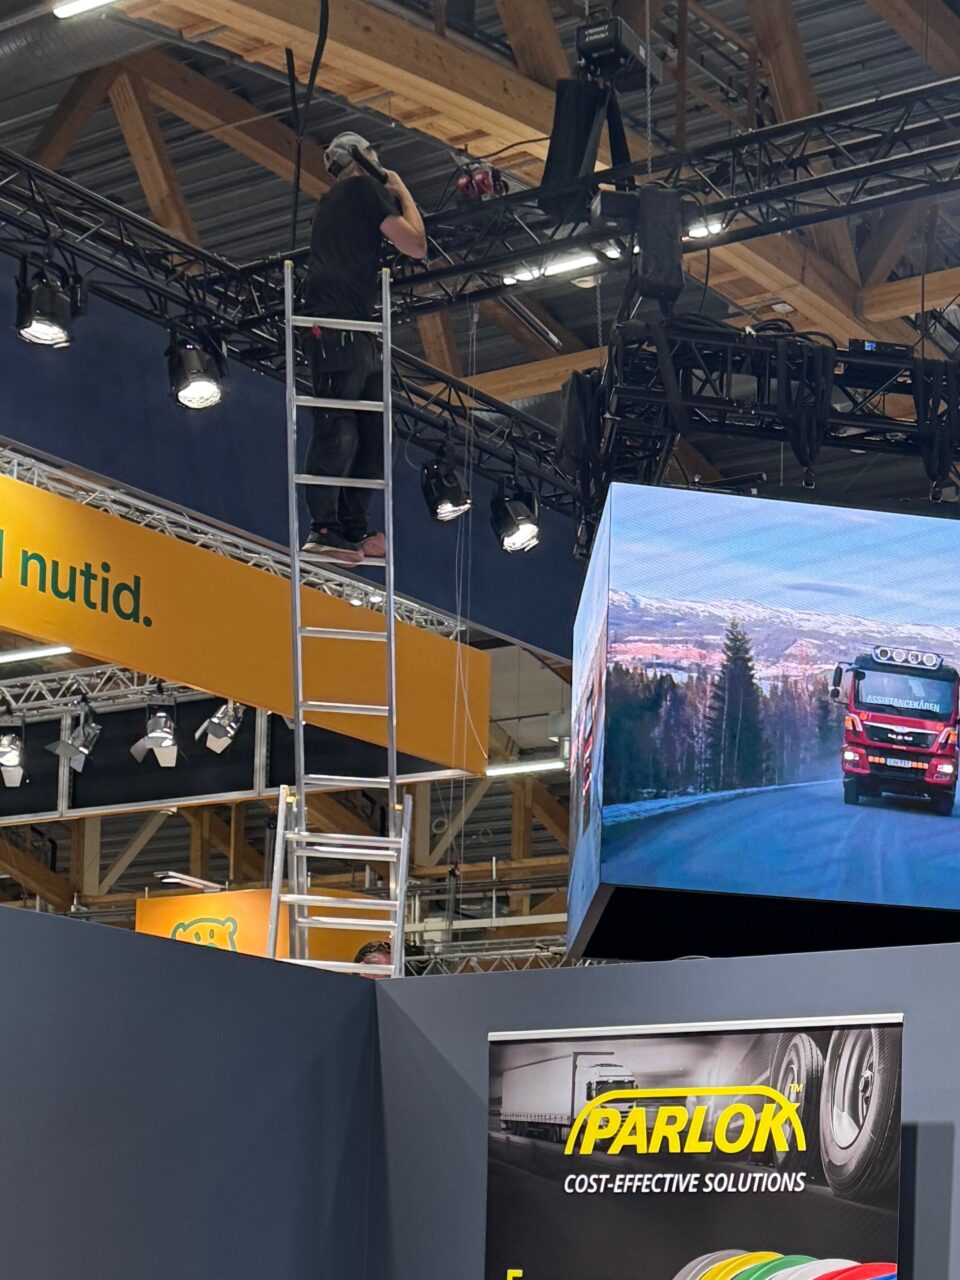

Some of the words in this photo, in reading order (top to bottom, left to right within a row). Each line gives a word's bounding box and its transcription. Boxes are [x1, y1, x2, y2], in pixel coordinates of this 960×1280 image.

[21, 549, 152, 627] nutid.
[578, 1103, 801, 1155] PARLOK
[564, 1173, 700, 1193] COST-EFFECTIVE
[702, 1172, 806, 1193] SOLUTIONS
